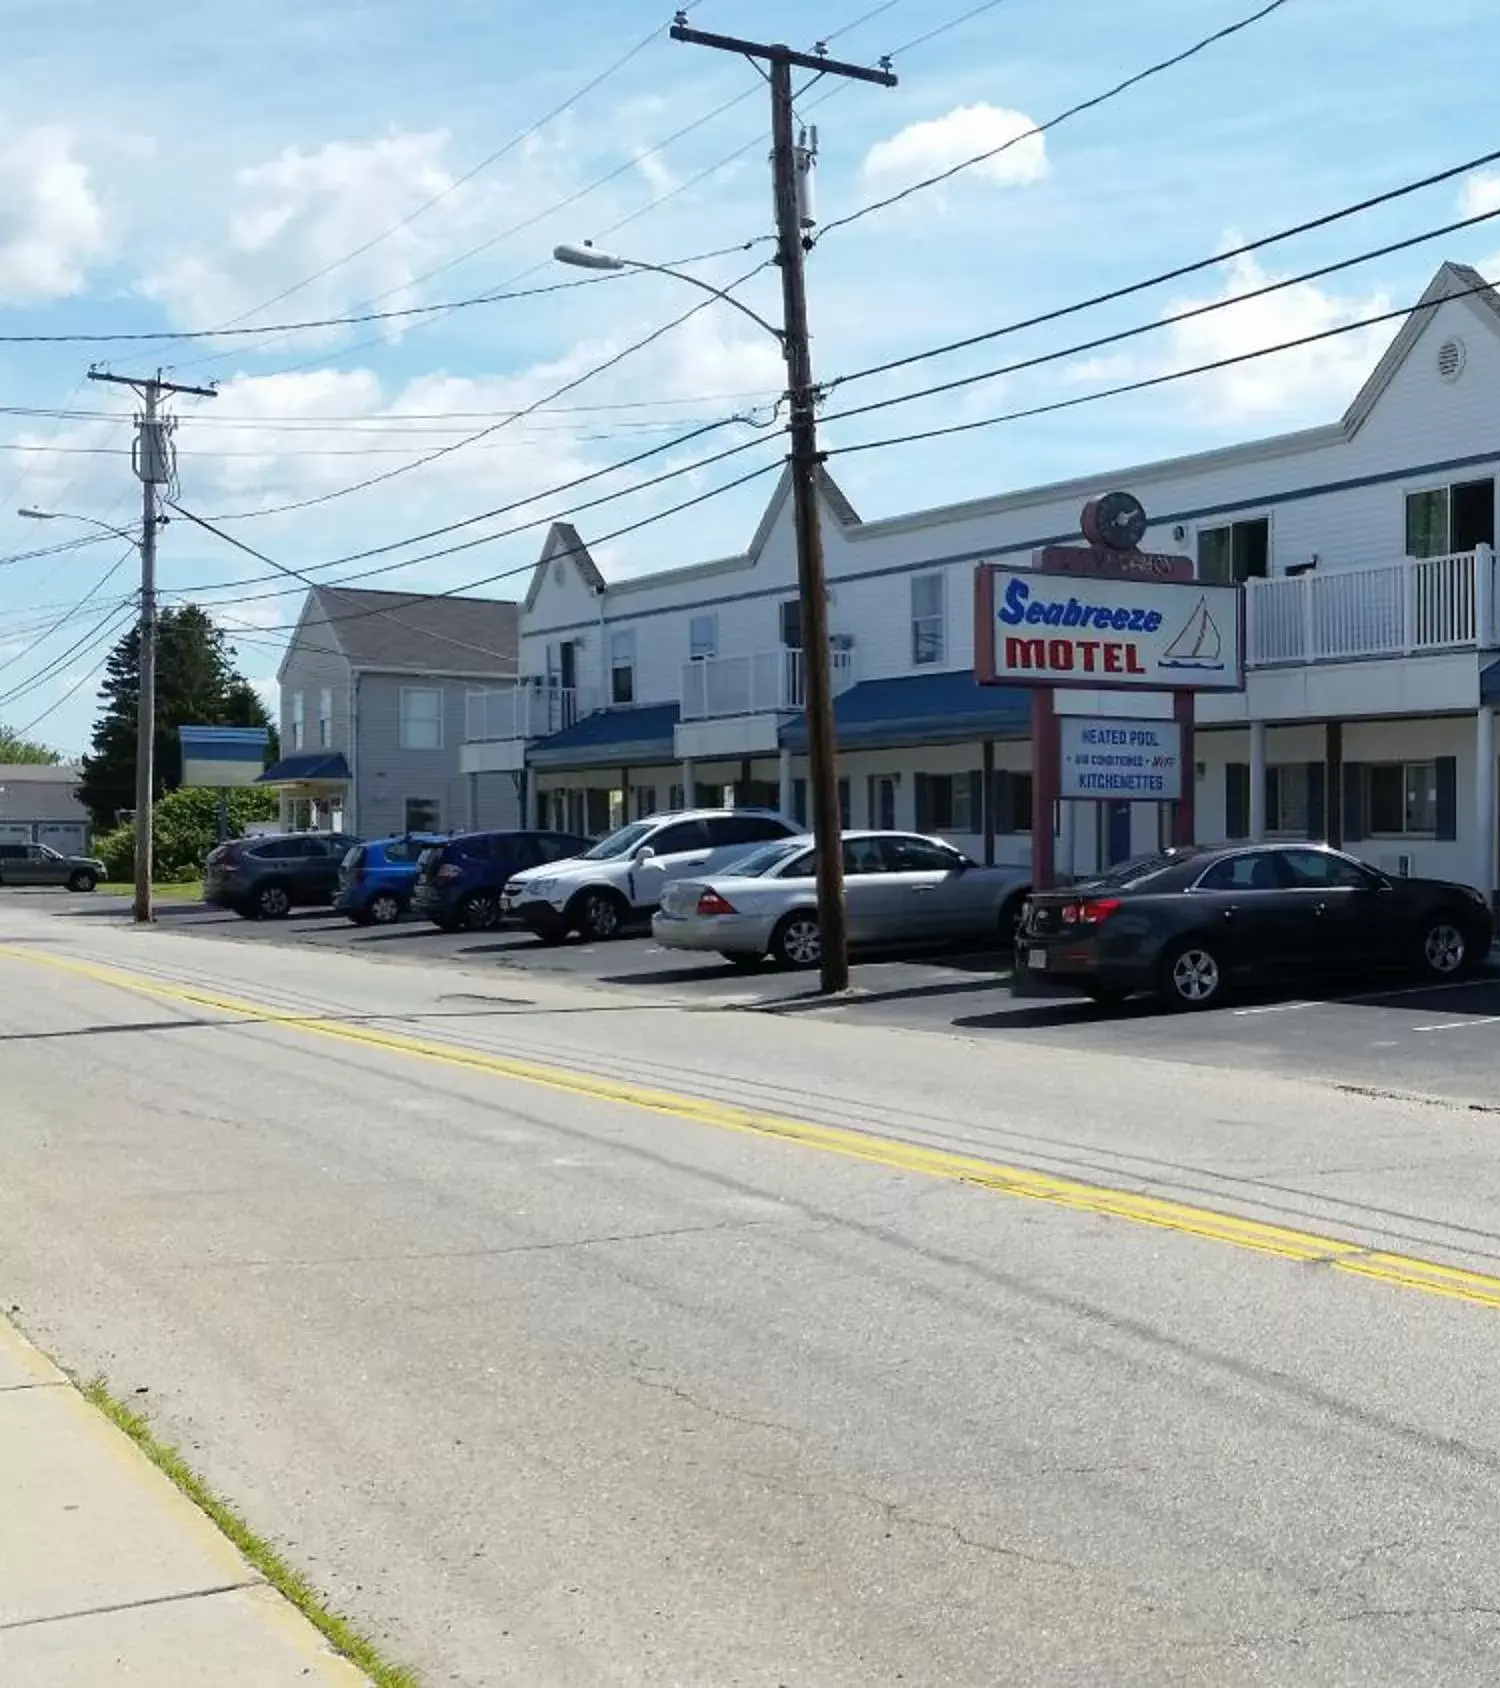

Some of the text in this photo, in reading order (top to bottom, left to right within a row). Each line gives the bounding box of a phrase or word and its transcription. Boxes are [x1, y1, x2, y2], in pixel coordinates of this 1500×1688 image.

[998, 576, 1163, 633] Seabreeze
[1006, 637, 1147, 675] MOTEL
[1081, 728, 1160, 747] HEATED POOL
[1078, 772, 1164, 791] KITCHENETTES
